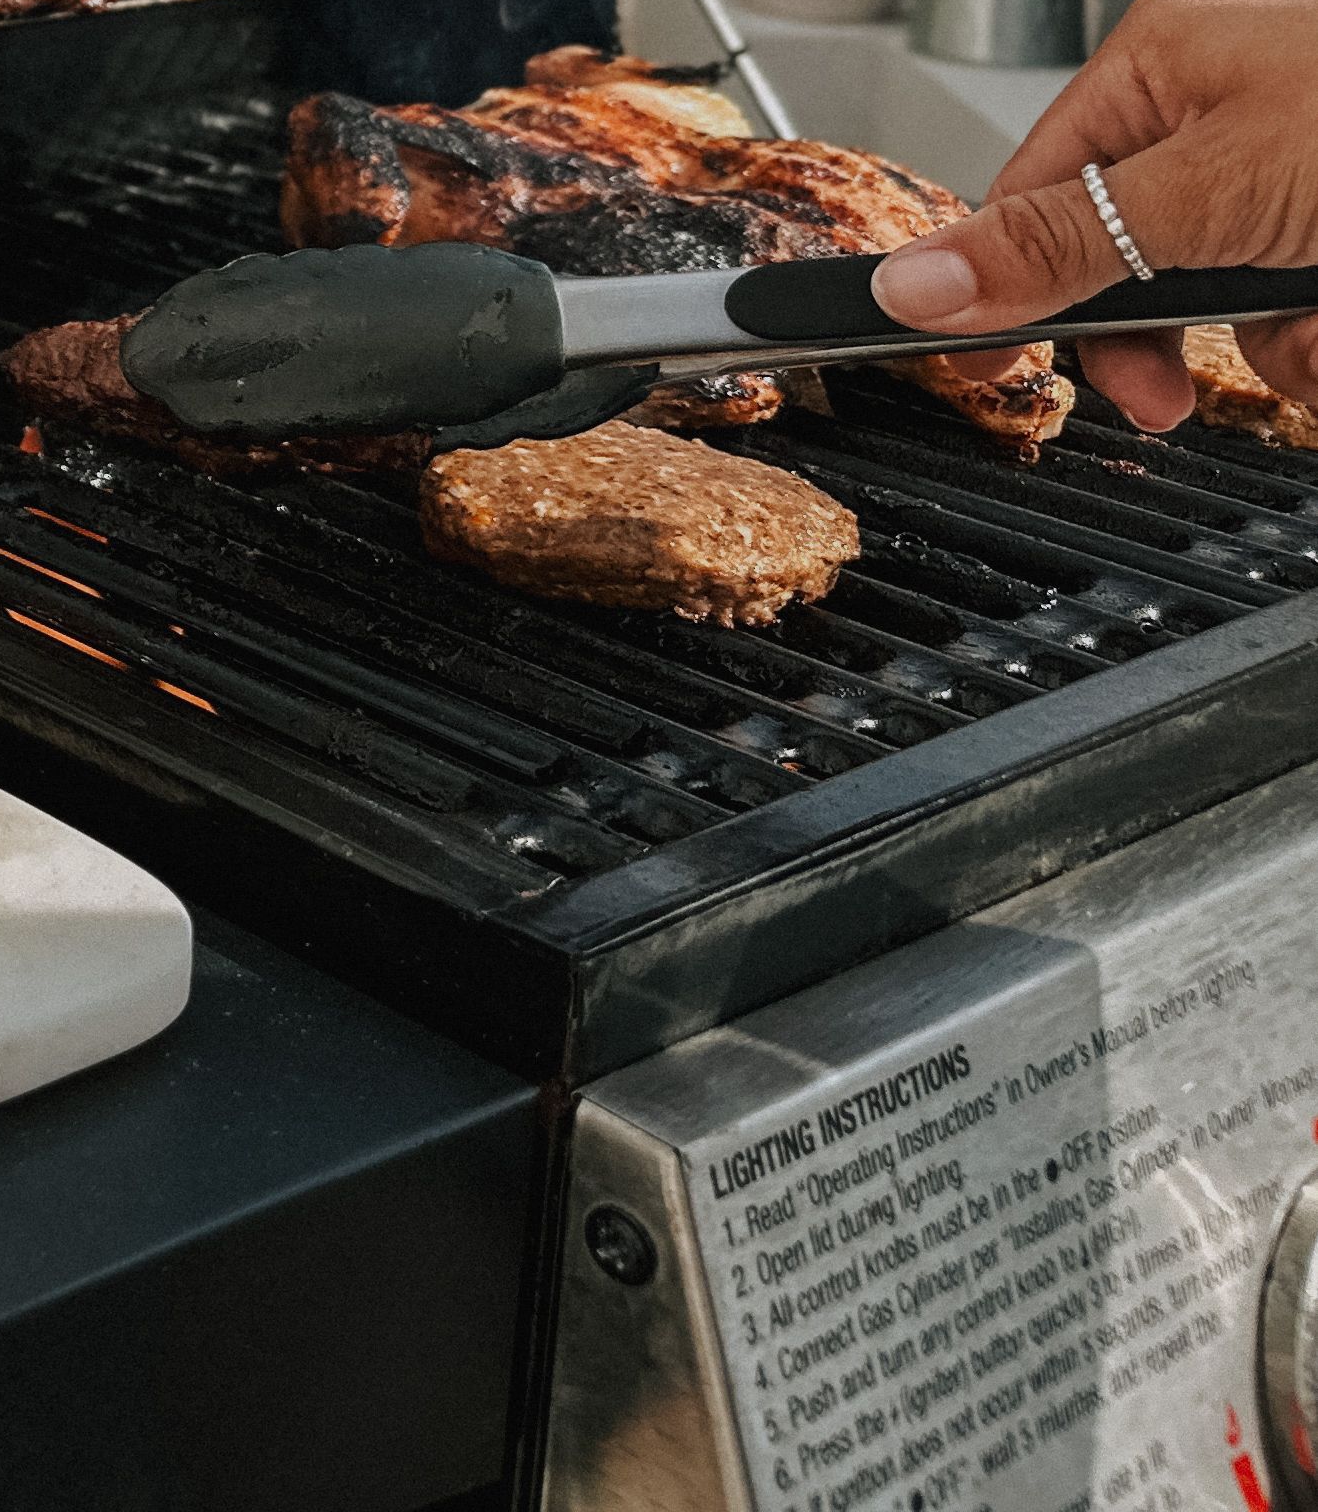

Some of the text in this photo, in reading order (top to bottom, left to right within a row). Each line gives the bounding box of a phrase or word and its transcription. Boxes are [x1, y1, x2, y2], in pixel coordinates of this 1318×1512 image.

[709, 1043, 970, 1200] LIGHTING INSTRUCTIONS
[744, 1187, 795, 1238] Read
[1005, 1078, 1023, 1105] in
[1091, 1015, 1148, 1059] Manual
[1149, 988, 1195, 1030] before
[731, 1264, 749, 1299] 2.
[756, 1240, 807, 1286] Open
[808, 1219, 834, 1257] lid
[837, 1195, 896, 1244] during
[741, 1312, 763, 1347] 3.
[796, 1259, 862, 1318] control
[862, 1234, 920, 1279] knobs
[921, 1204, 966, 1250] must
[966, 1195, 990, 1225] be
[993, 1184, 1010, 1212] in
[1011, 1168, 1040, 1201] the
[1062, 1130, 1094, 1173] OFF
[755, 1363, 773, 1391] 4.
[777, 1316, 856, 1382] Connect
[859, 1298, 895, 1337] Gas
[896, 1257, 968, 1317] Cylinder
[971, 1241, 999, 1279] per
[1085, 1174, 1115, 1209] Gas
[1192, 1124, 1204, 1151] in
[787, 1381, 838, 1429] Push
[842, 1355, 877, 1401] and
[878, 1338, 917, 1379] turn
[921, 1321, 952, 1357] any
[954, 1278, 1013, 1336] control
[1015, 1257, 1057, 1299] knob
[1058, 1248, 1077, 1274] to
[902, 1428, 945, 1474] does
[947, 1406, 977, 1439] not
[980, 1379, 1024, 1426] occur
[1027, 1346, 1078, 1394] within
[797, 1428, 854, 1478] Press
[855, 1409, 886, 1445] the
